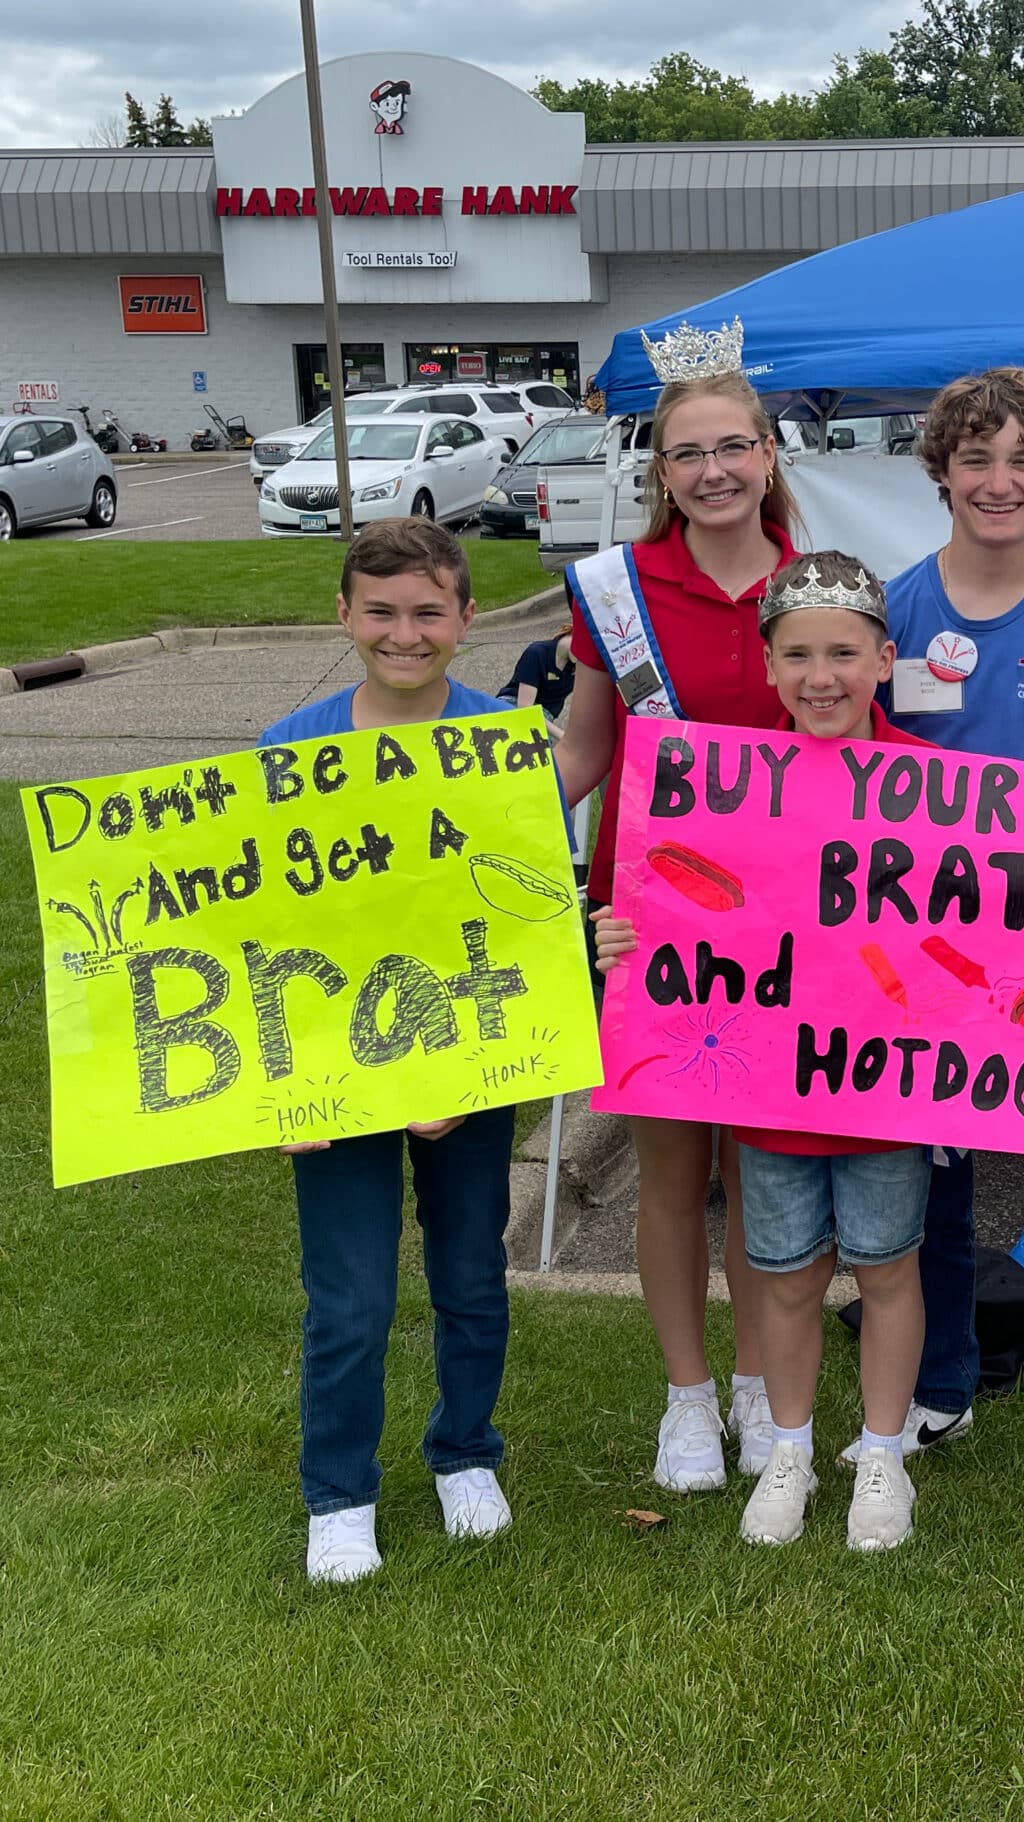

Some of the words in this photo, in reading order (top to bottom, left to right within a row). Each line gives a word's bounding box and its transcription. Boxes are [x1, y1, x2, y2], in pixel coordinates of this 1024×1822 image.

[216, 187, 443, 217] HARDWARE
[461, 186, 579, 215] HANK
[346, 253, 372, 265] Tool
[376, 252, 424, 265] Rentals
[428, 252, 453, 265] Too!
[127, 294, 197, 314] STIHL
[418, 362, 441, 373] OPEN
[461, 362, 481, 370] TORO
[498, 356, 513, 364] LIVE
[19, 383, 57, 400] RENTALS
[619, 643, 646, 668] 2023
[36, 765, 237, 853] Don't
[256, 747, 349, 805] Be
[375, 732, 417, 785] A
[431, 725, 552, 779] Brat
[648, 736, 800, 818] BUY
[840, 746, 1019, 834] YOUR
[145, 837, 264, 926] And
[284, 823, 395, 896] get
[430, 807, 469, 860] A
[645, 931, 794, 1008] and
[126, 917, 529, 1113] Brat
[481, 1053, 546, 1089] HONK
[276, 1096, 350, 1132] HONK
